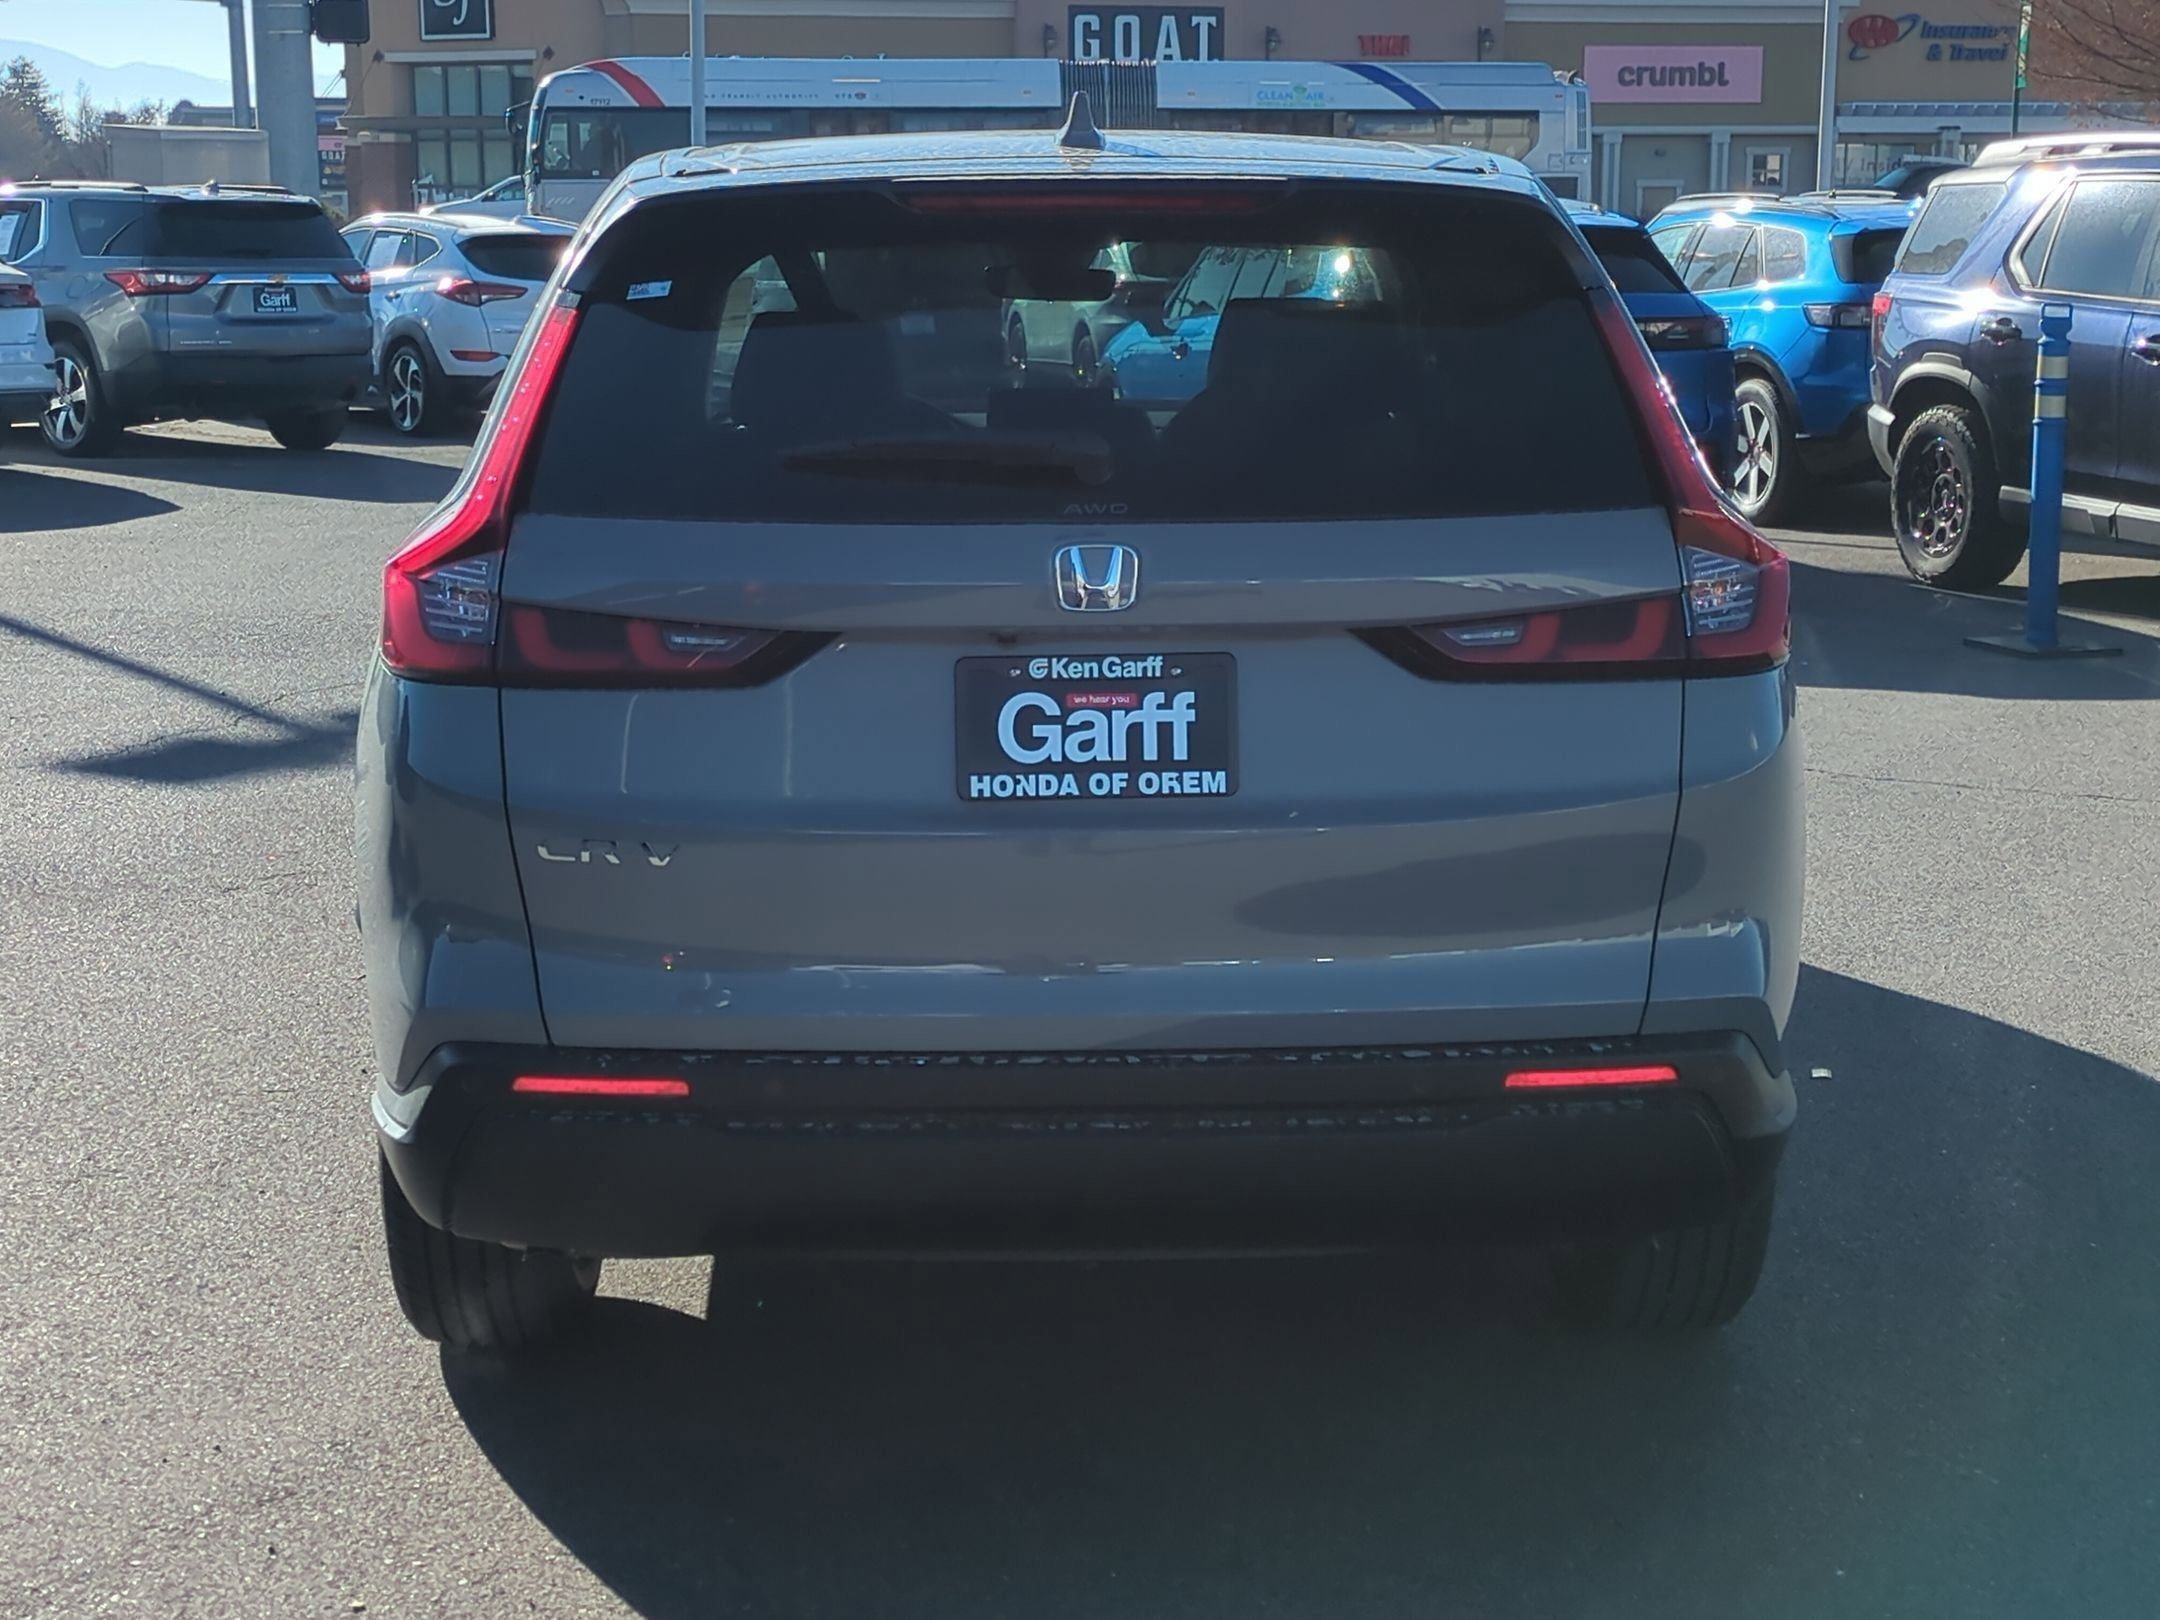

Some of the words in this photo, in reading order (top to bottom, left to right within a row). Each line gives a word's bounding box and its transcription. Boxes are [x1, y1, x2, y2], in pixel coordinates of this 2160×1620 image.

[1074, 15, 1217, 62] GOAT
[1926, 43, 1942, 61] &
[1950, 44, 2008, 61] Travel
[1617, 62, 1729, 87] crumbl
[1256, 90, 1293, 100] CLEAN
[1063, 503, 1129, 514] AWD
[1051, 658, 1098, 679] Ken
[1102, 656, 1164, 678] Garff
[1073, 696, 1087, 704] we
[1089, 694, 1109, 704] hear
[1112, 696, 1130, 705] you
[997, 691, 1195, 764] Garff
[970, 774, 1080, 798] HONDA
[1088, 773, 1129, 795] OF
[1137, 771, 1227, 795] OREM
